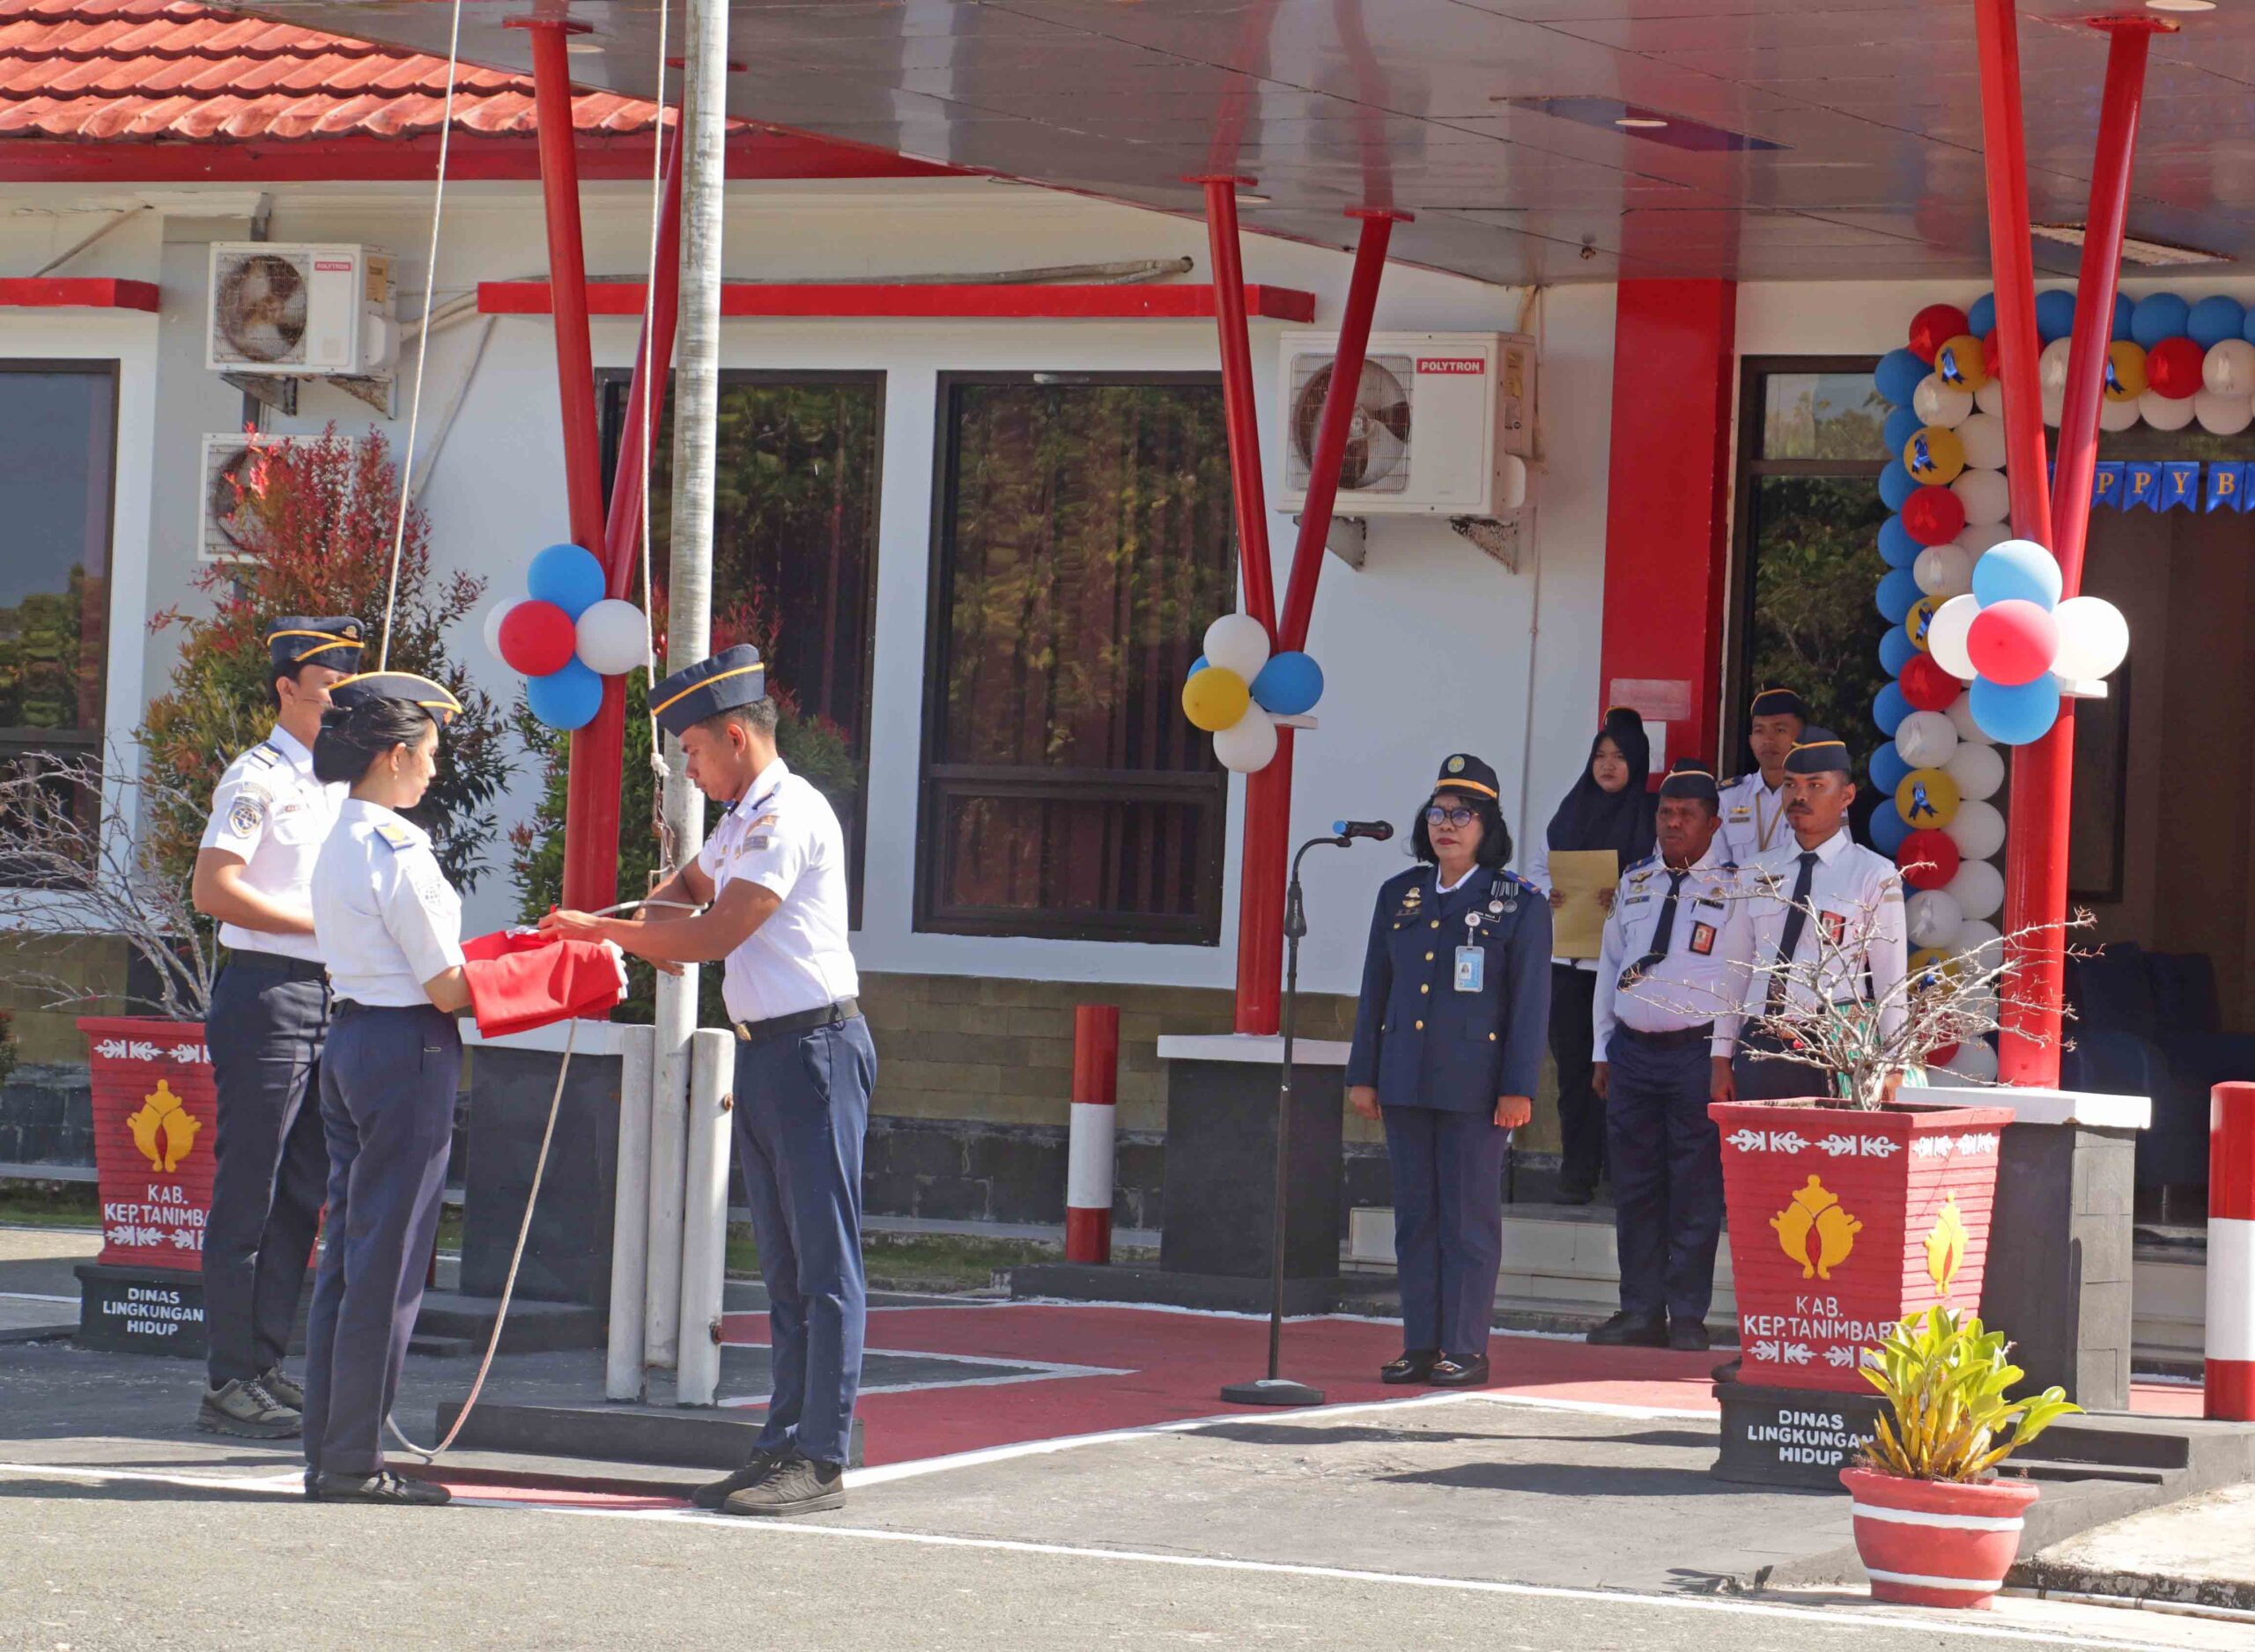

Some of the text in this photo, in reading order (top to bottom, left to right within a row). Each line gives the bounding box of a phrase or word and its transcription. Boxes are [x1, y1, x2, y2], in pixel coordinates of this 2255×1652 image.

[1421, 361, 1481, 372] POLYTRON
[2096, 471, 2191, 494] PPY
[147, 1184, 189, 1205] KAB.
[128, 1287, 180, 1304] DINAS
[103, 1301, 204, 1322] LINGKUNGAN
[1796, 1296, 1844, 1317] KAB.
[127, 1320, 178, 1336] HIDUP
[1778, 1410, 1844, 1430] DINAS
[1778, 1447, 1843, 1465] HIDUP
